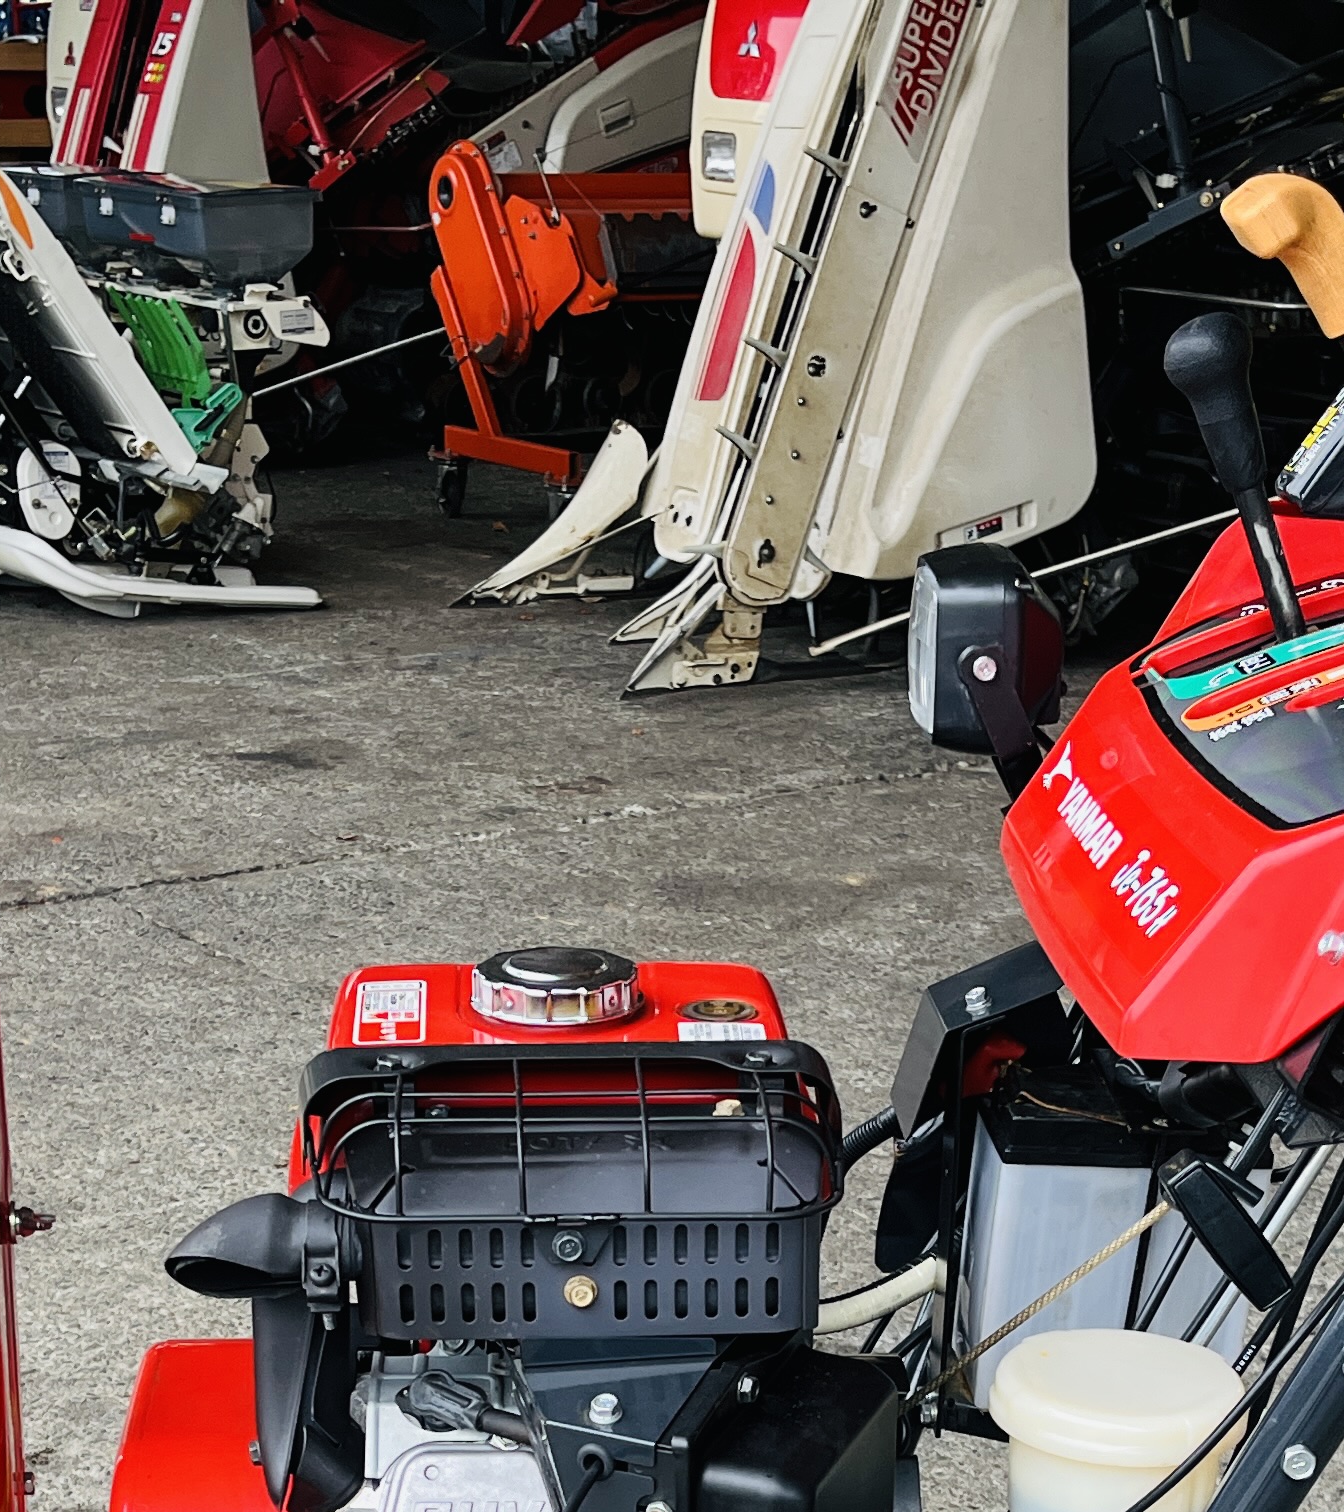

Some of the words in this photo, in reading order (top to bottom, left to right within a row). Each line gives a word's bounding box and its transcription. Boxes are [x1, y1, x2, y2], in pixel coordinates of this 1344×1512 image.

[892, 0, 937, 90] SUPE
[909, 0, 965, 118] DIVIDE
[1057, 776, 1124, 871] YANMAR
